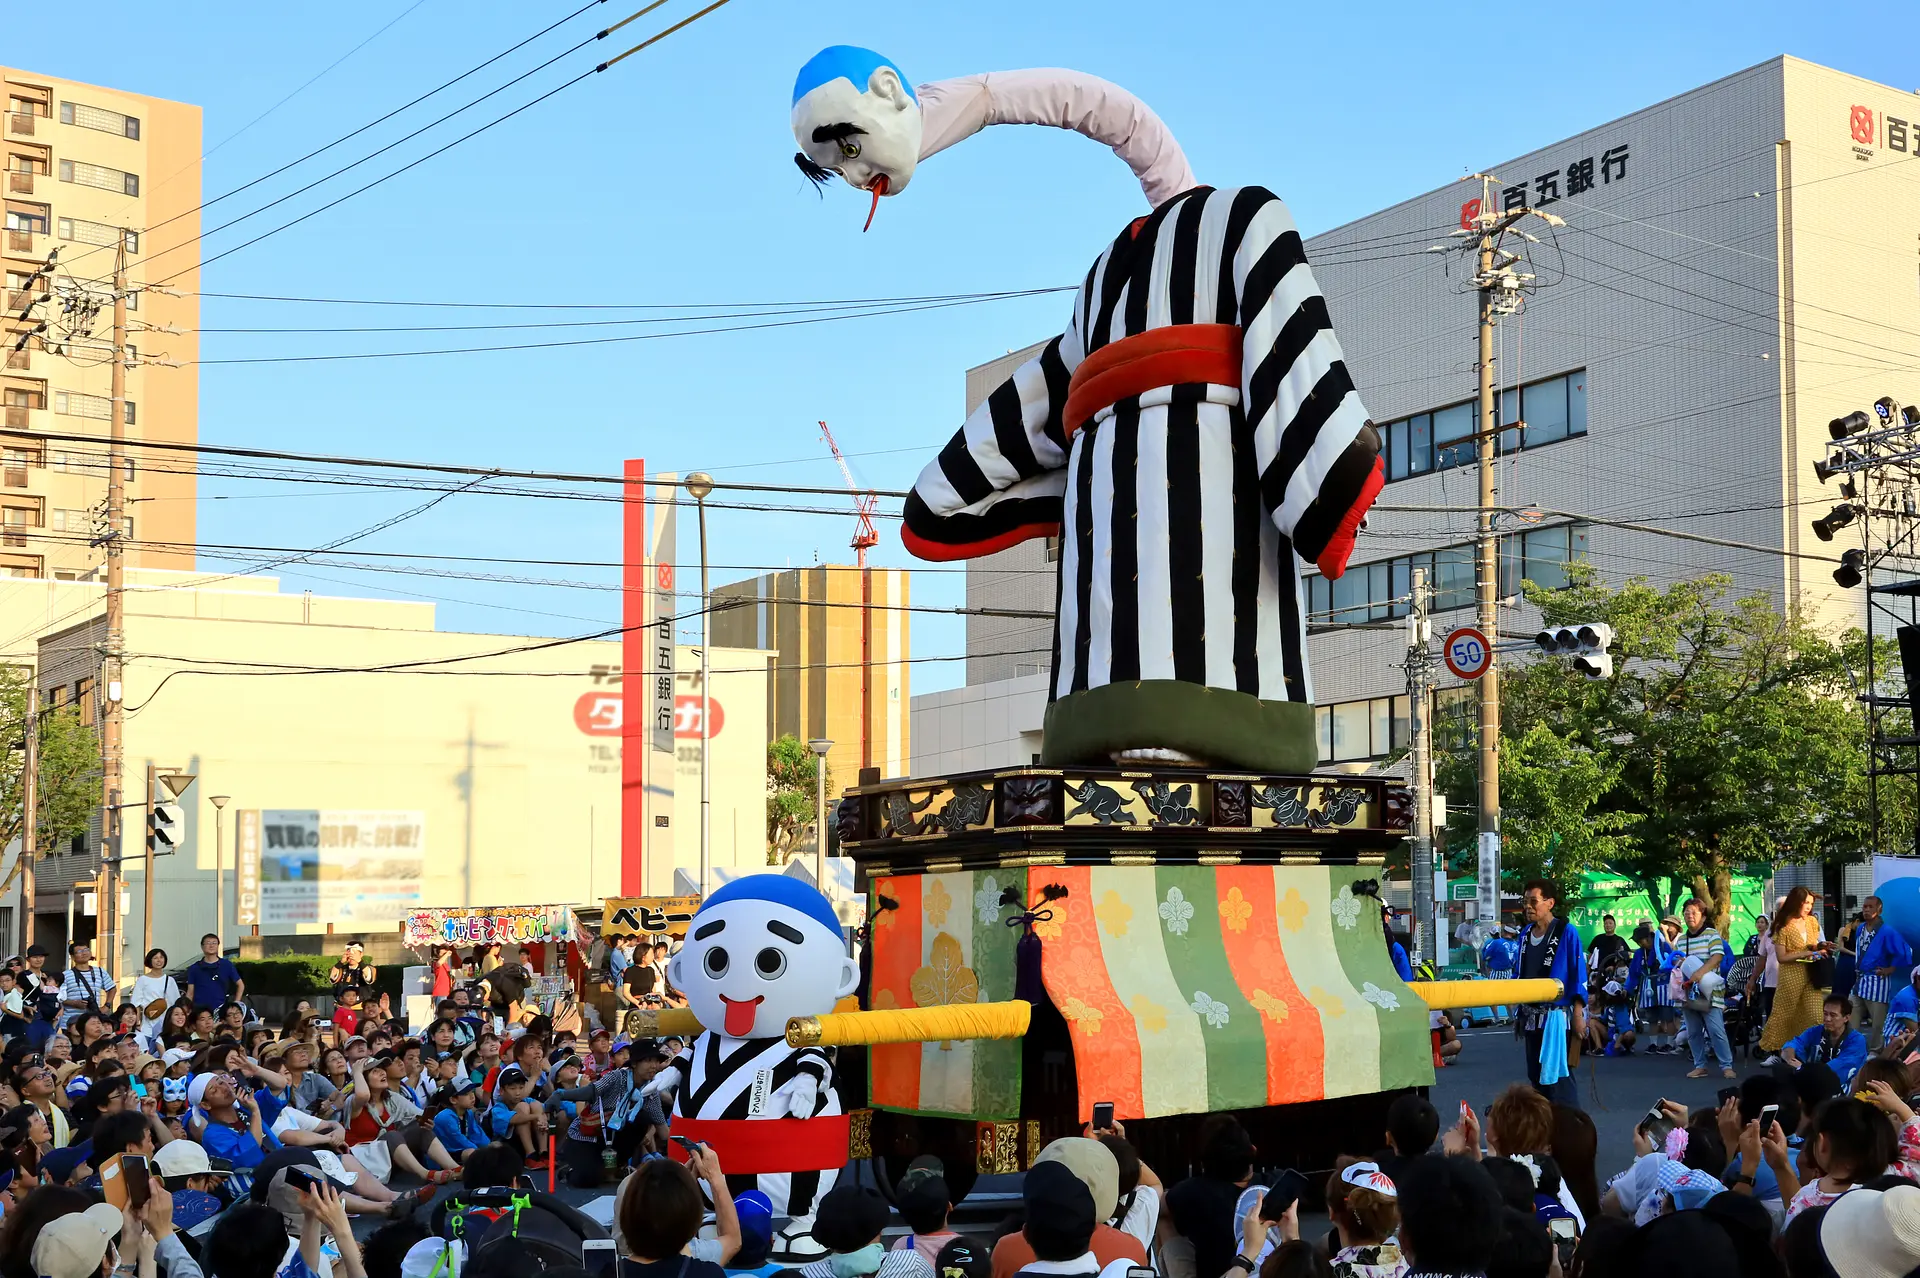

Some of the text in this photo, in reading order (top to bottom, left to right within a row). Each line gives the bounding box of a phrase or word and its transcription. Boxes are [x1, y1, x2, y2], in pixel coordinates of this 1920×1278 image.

[1502, 143, 1629, 214] 百五銀行
[1452, 641, 1482, 667] 50
[657, 616, 671, 731] 百五銀行
[443, 915, 548, 942] ポッピングボバ
[610, 907, 695, 932] ベビー
[1543, 936, 1559, 967] 大入道
